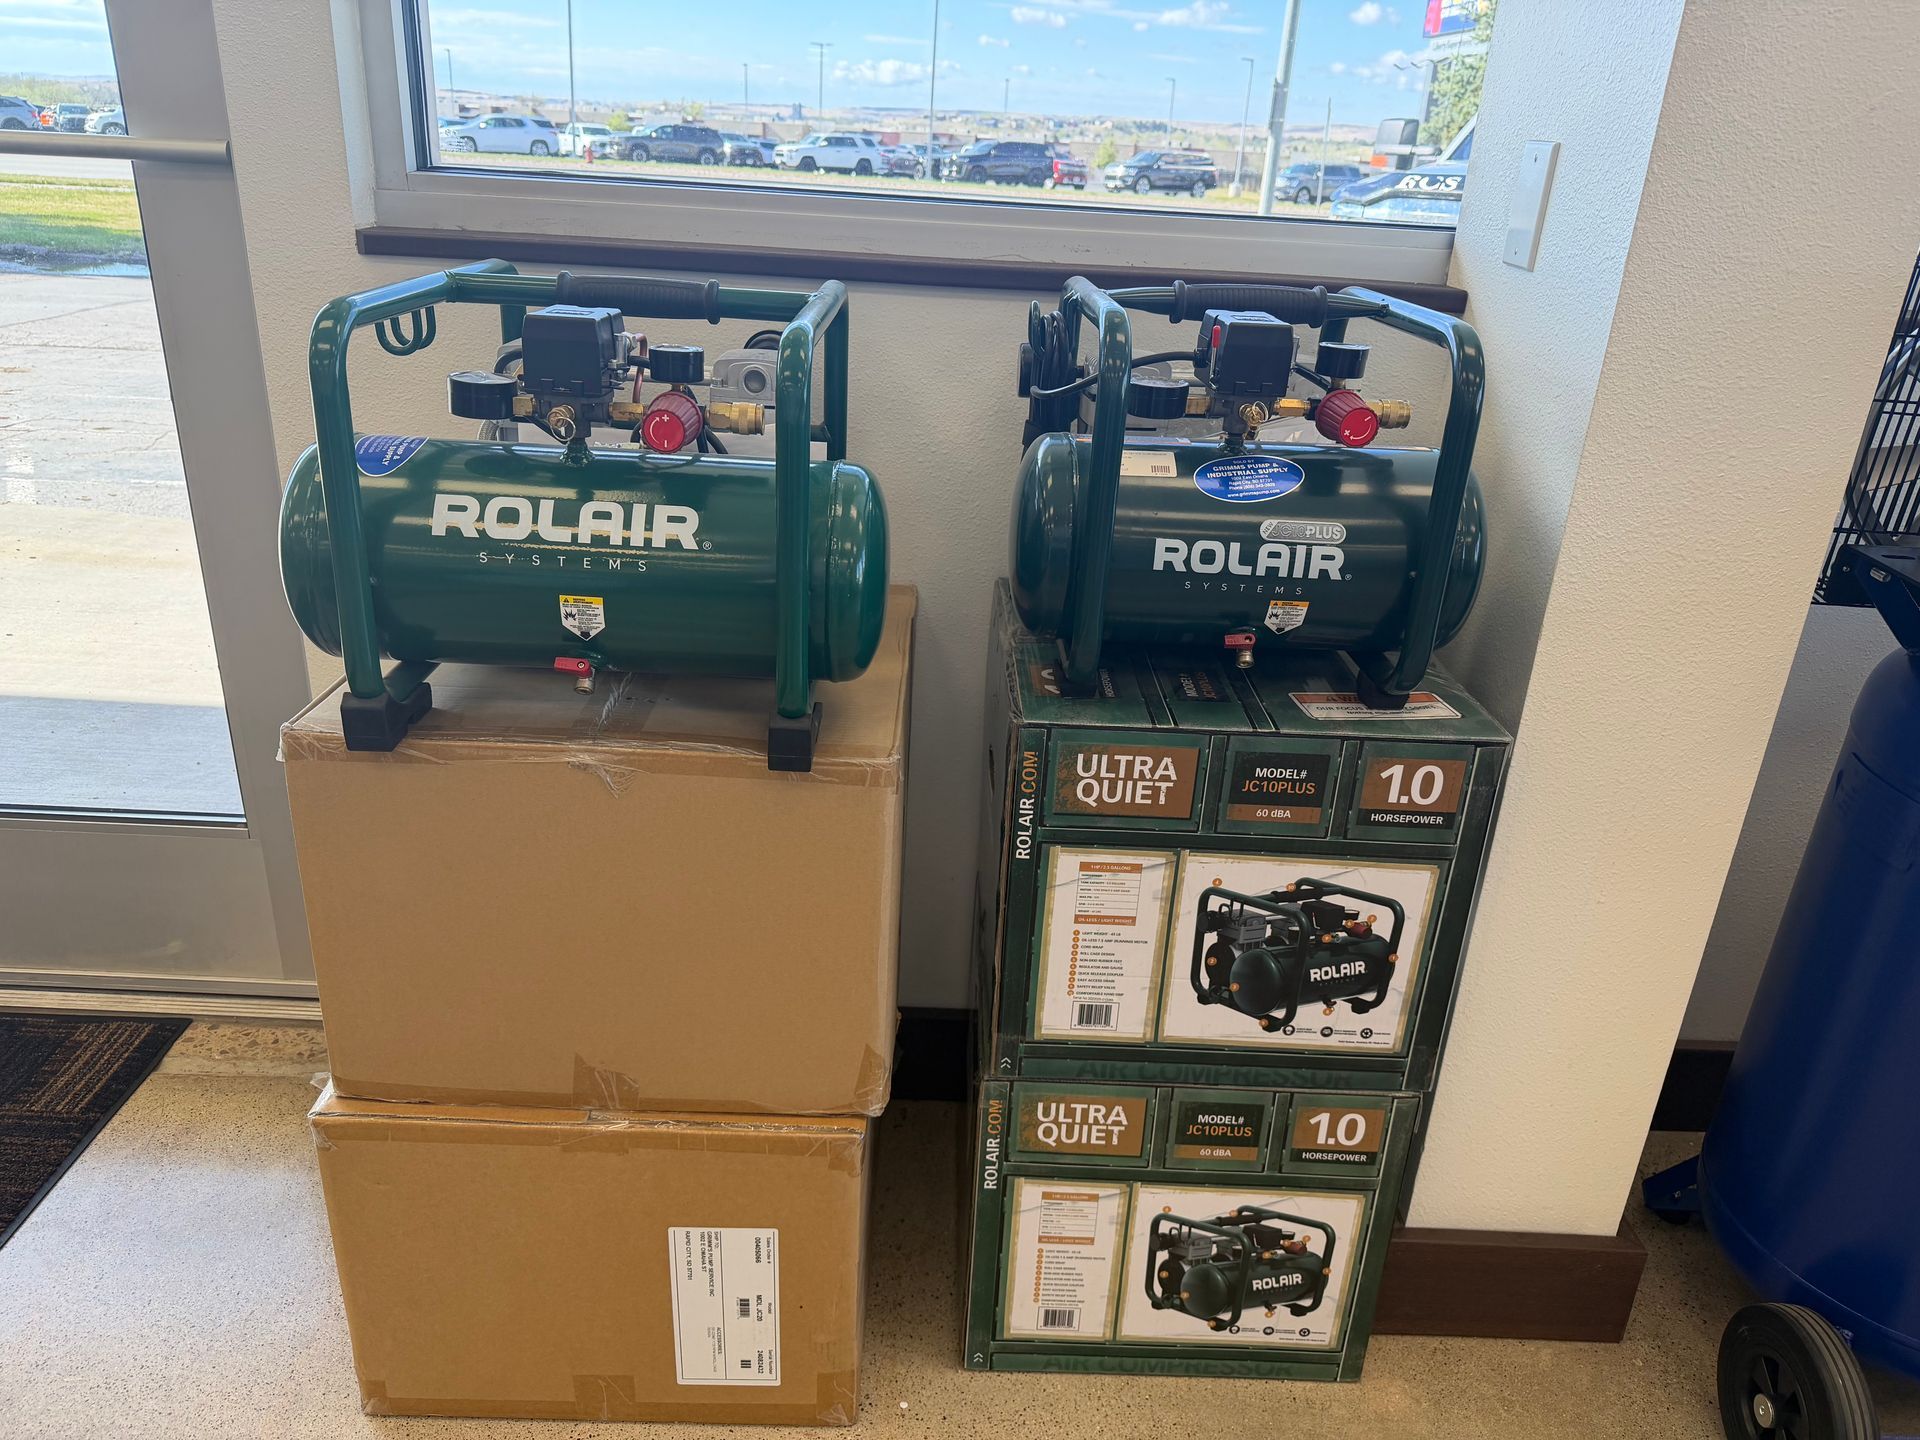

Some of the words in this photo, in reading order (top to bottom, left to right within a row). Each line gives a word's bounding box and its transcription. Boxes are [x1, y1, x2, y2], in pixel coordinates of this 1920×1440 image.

[1207, 469, 1256, 478] INDUSTRIAL
[431, 494, 700, 550] ROLAIR
[1262, 521, 1273, 534] NEW
[478, 552, 647, 572] SYSTEMS
[1153, 538, 1344, 580] ROLAIR
[1184, 581, 1302, 595] SYSTEMS
[1076, 753, 1177, 780] ULTRA
[1255, 767, 1308, 780] MODEL#
[1076, 778, 1174, 808] QUIET
[1241, 780, 1316, 795] JC10PLUS
[1379, 764, 1444, 806] 1.0
[1016, 751, 1039, 859] ROLAIR.COM
[1256, 808, 1269, 818] 60
[1271, 809, 1291, 819] dBA
[1370, 812, 1444, 825] HORSEPOWER
[1309, 961, 1366, 982] ROLAIR
[1037, 1102, 1128, 1125] ULTRA
[1197, 1114, 1244, 1125] MODEL#
[1037, 1123, 1126, 1147] QUIET
[1186, 1124, 1252, 1137] JC10PLUS
[1309, 1113, 1366, 1146] 1.0
[984, 1098, 1003, 1189] ROLAIR.COM
[1302, 1152, 1367, 1162] HORSEPOWER
[1252, 1273, 1302, 1291] ROLAIR
